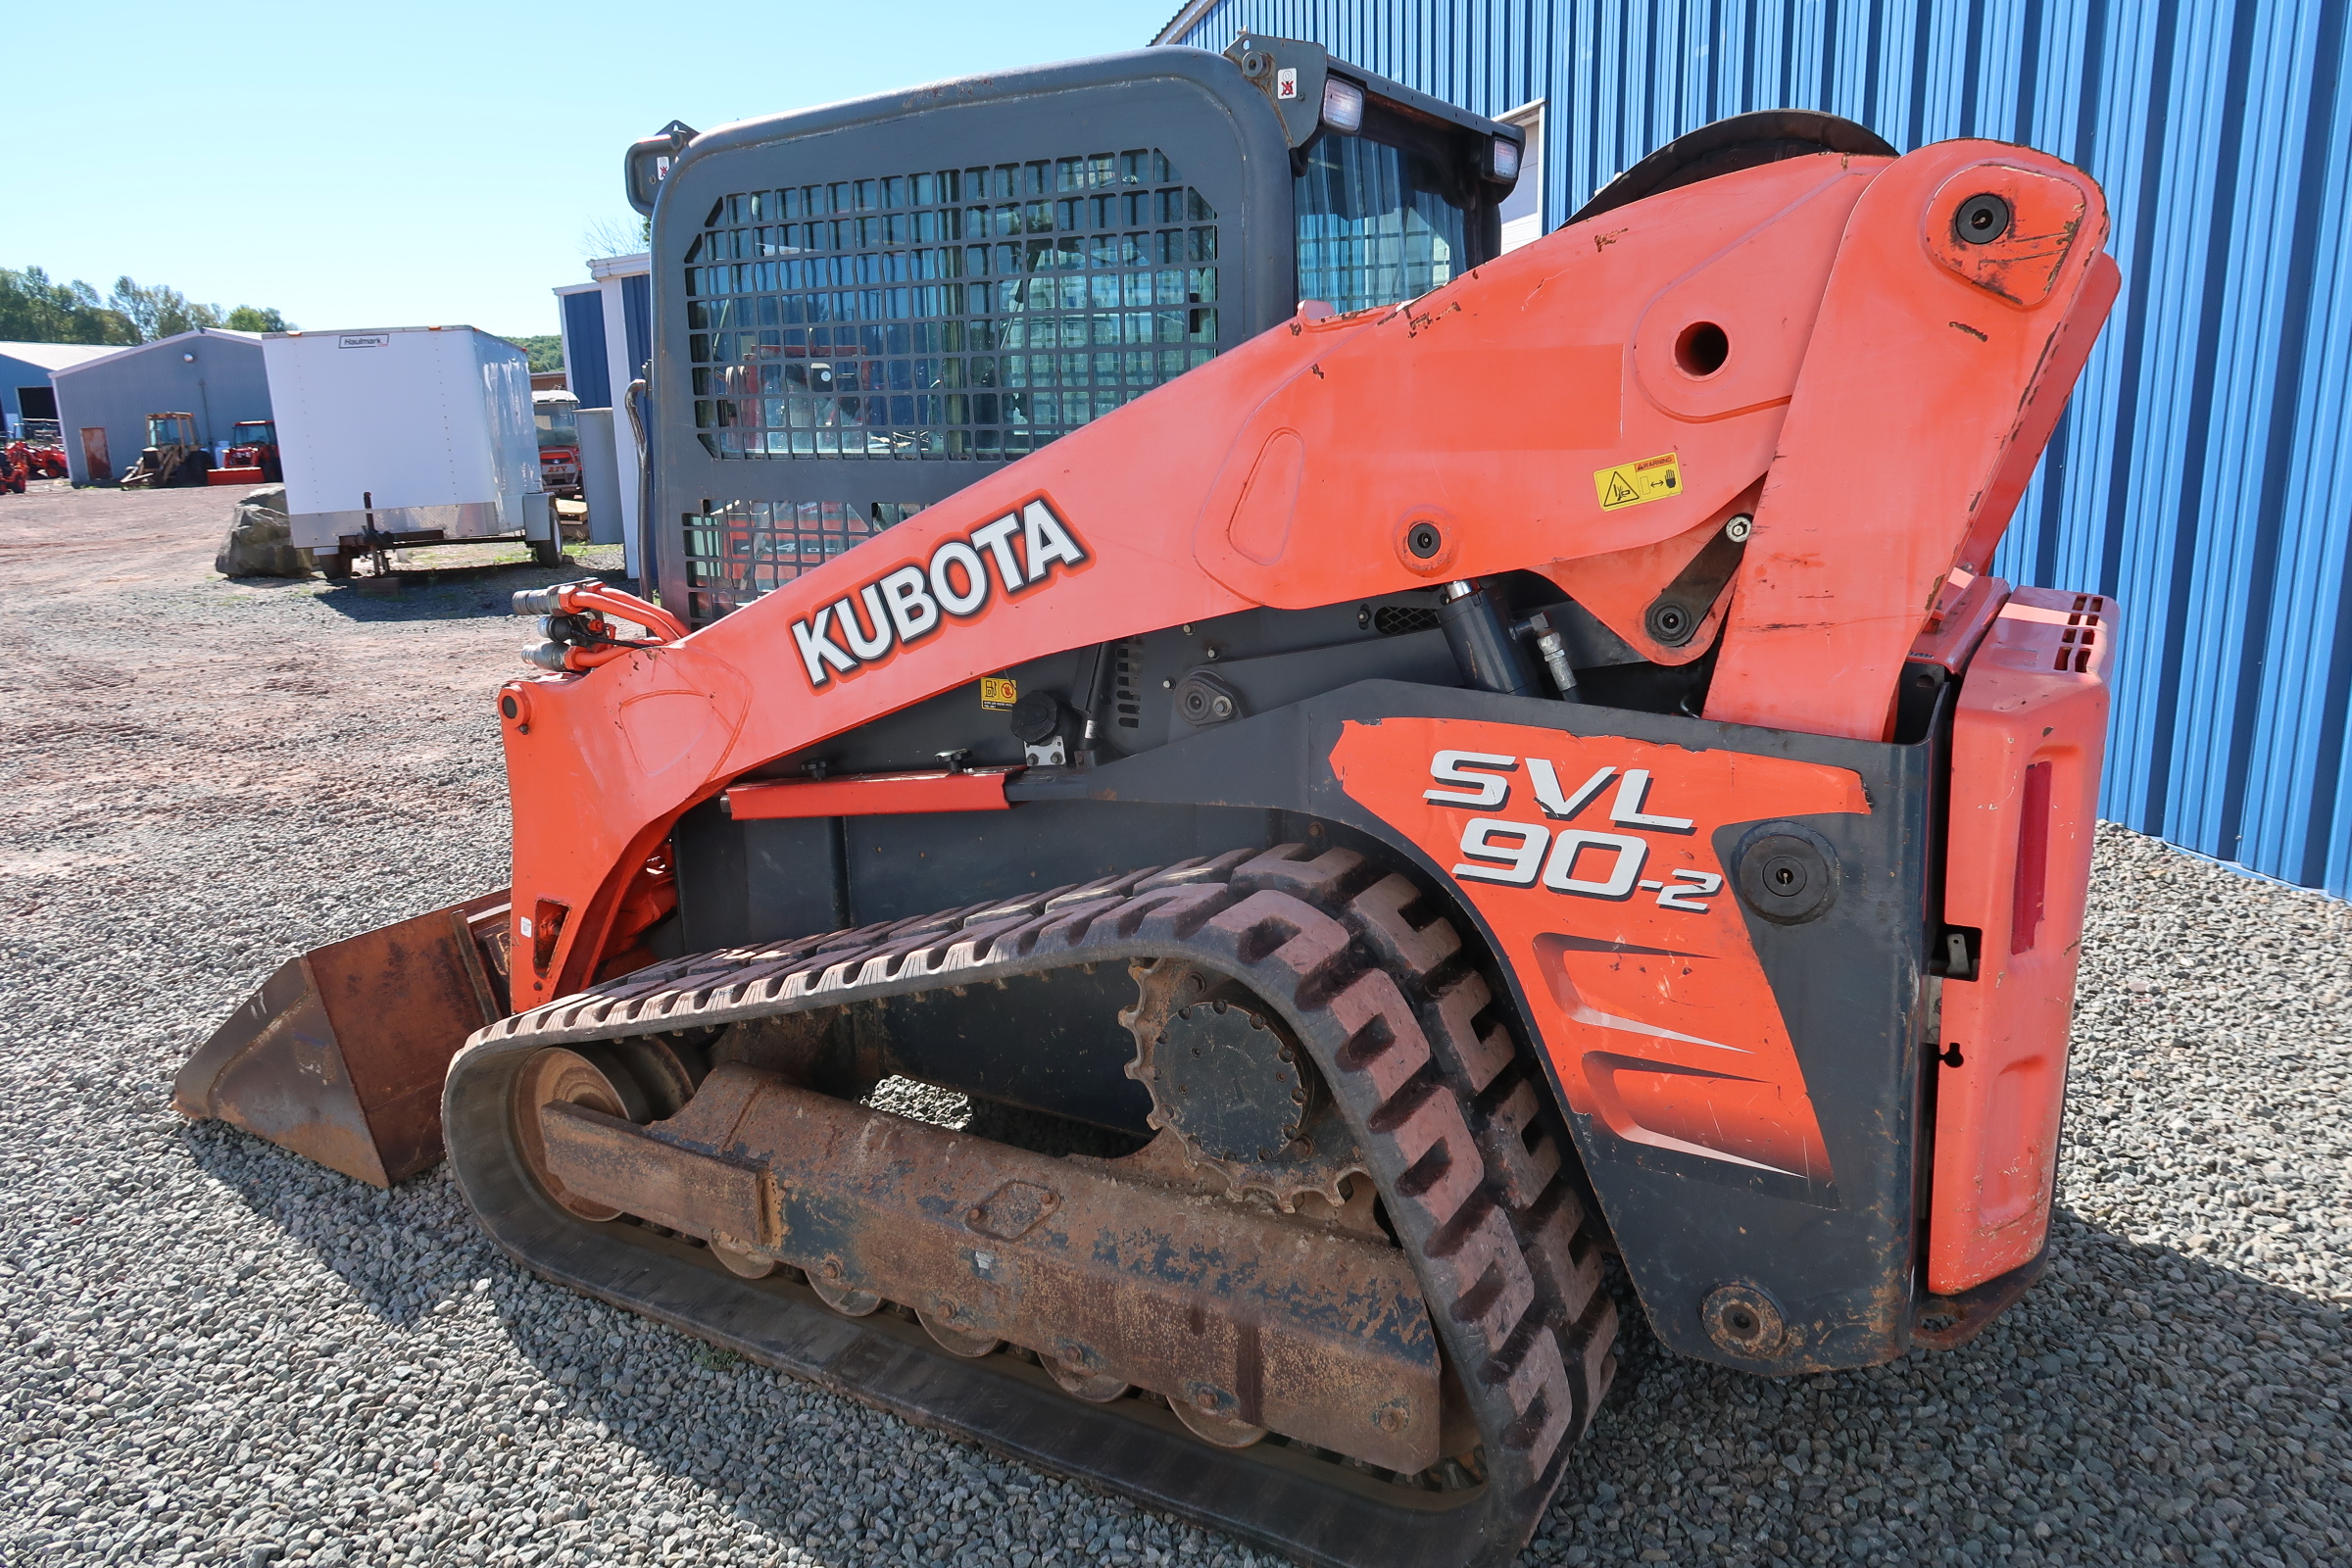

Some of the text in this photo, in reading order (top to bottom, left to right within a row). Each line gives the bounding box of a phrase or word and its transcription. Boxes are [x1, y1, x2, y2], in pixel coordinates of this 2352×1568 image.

[344, 337, 381, 346] Haulmark
[1642, 456, 1672, 468] WARNING
[791, 499, 1084, 686] KUBOTA
[1422, 750, 1697, 836] SVL
[1451, 817, 1723, 914] 90-2
